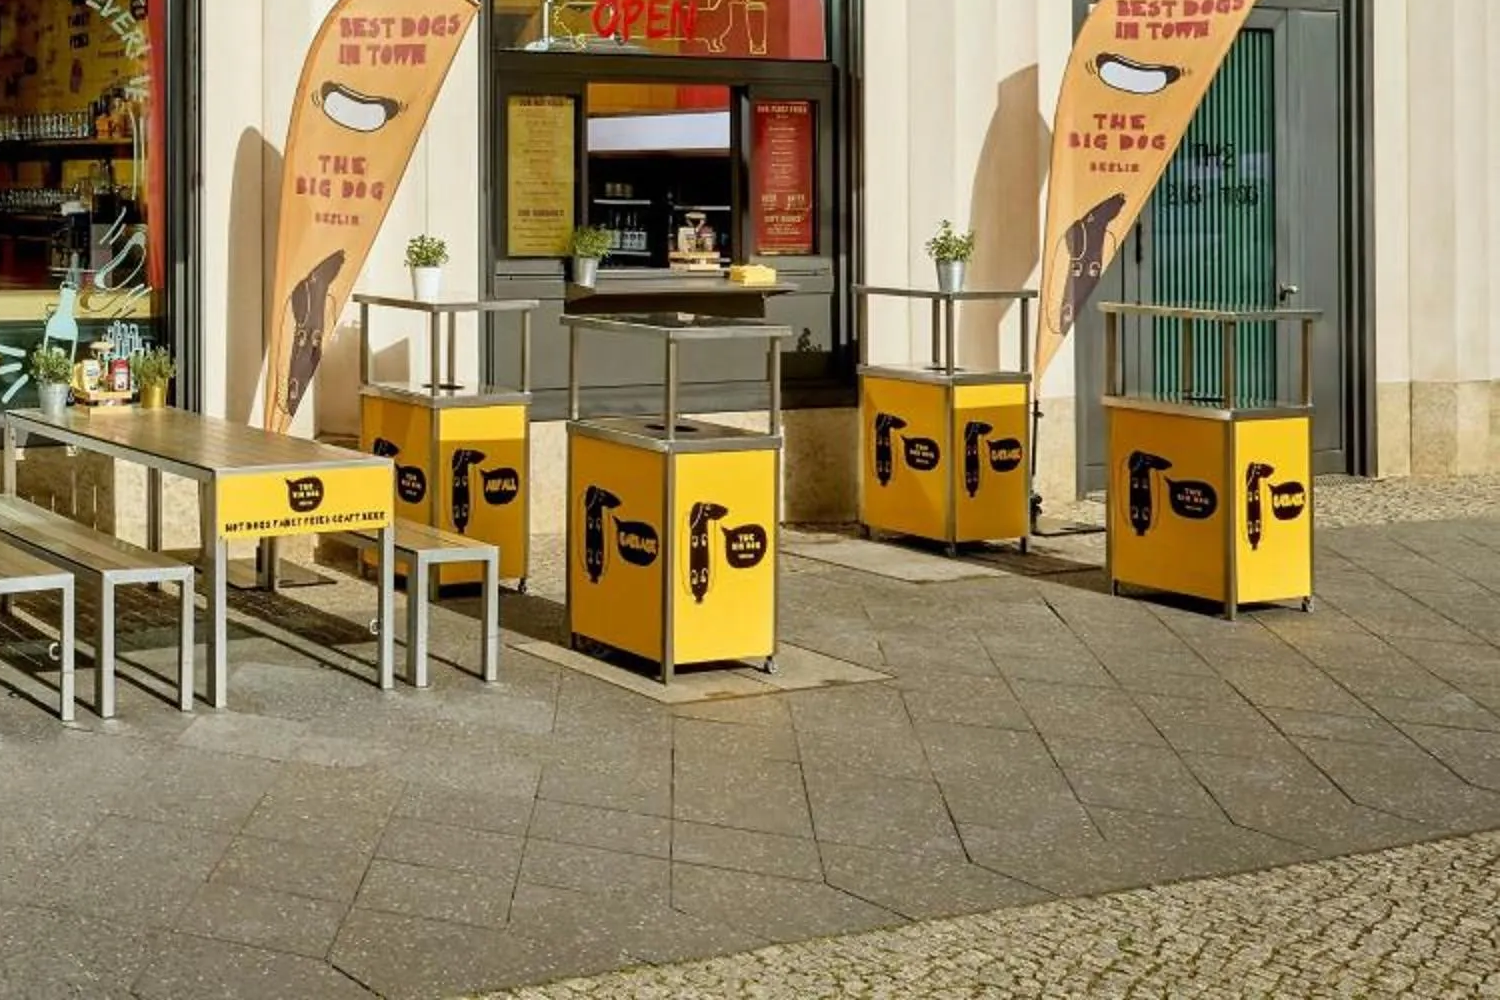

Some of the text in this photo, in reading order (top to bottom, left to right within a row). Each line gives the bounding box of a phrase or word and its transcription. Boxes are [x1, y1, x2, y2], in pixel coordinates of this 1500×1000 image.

[1116, 0, 1177, 18] BEST
[339, 13, 461, 39] BEST DOGS
[1114, 20, 1210, 41] IN TOWN
[338, 42, 426, 66] IN TOWN
[1092, 112, 1147, 130] THE
[1068, 131, 1166, 151] BIG DOG
[317, 154, 367, 175] THE
[295, 175, 385, 201] BIG DOG
